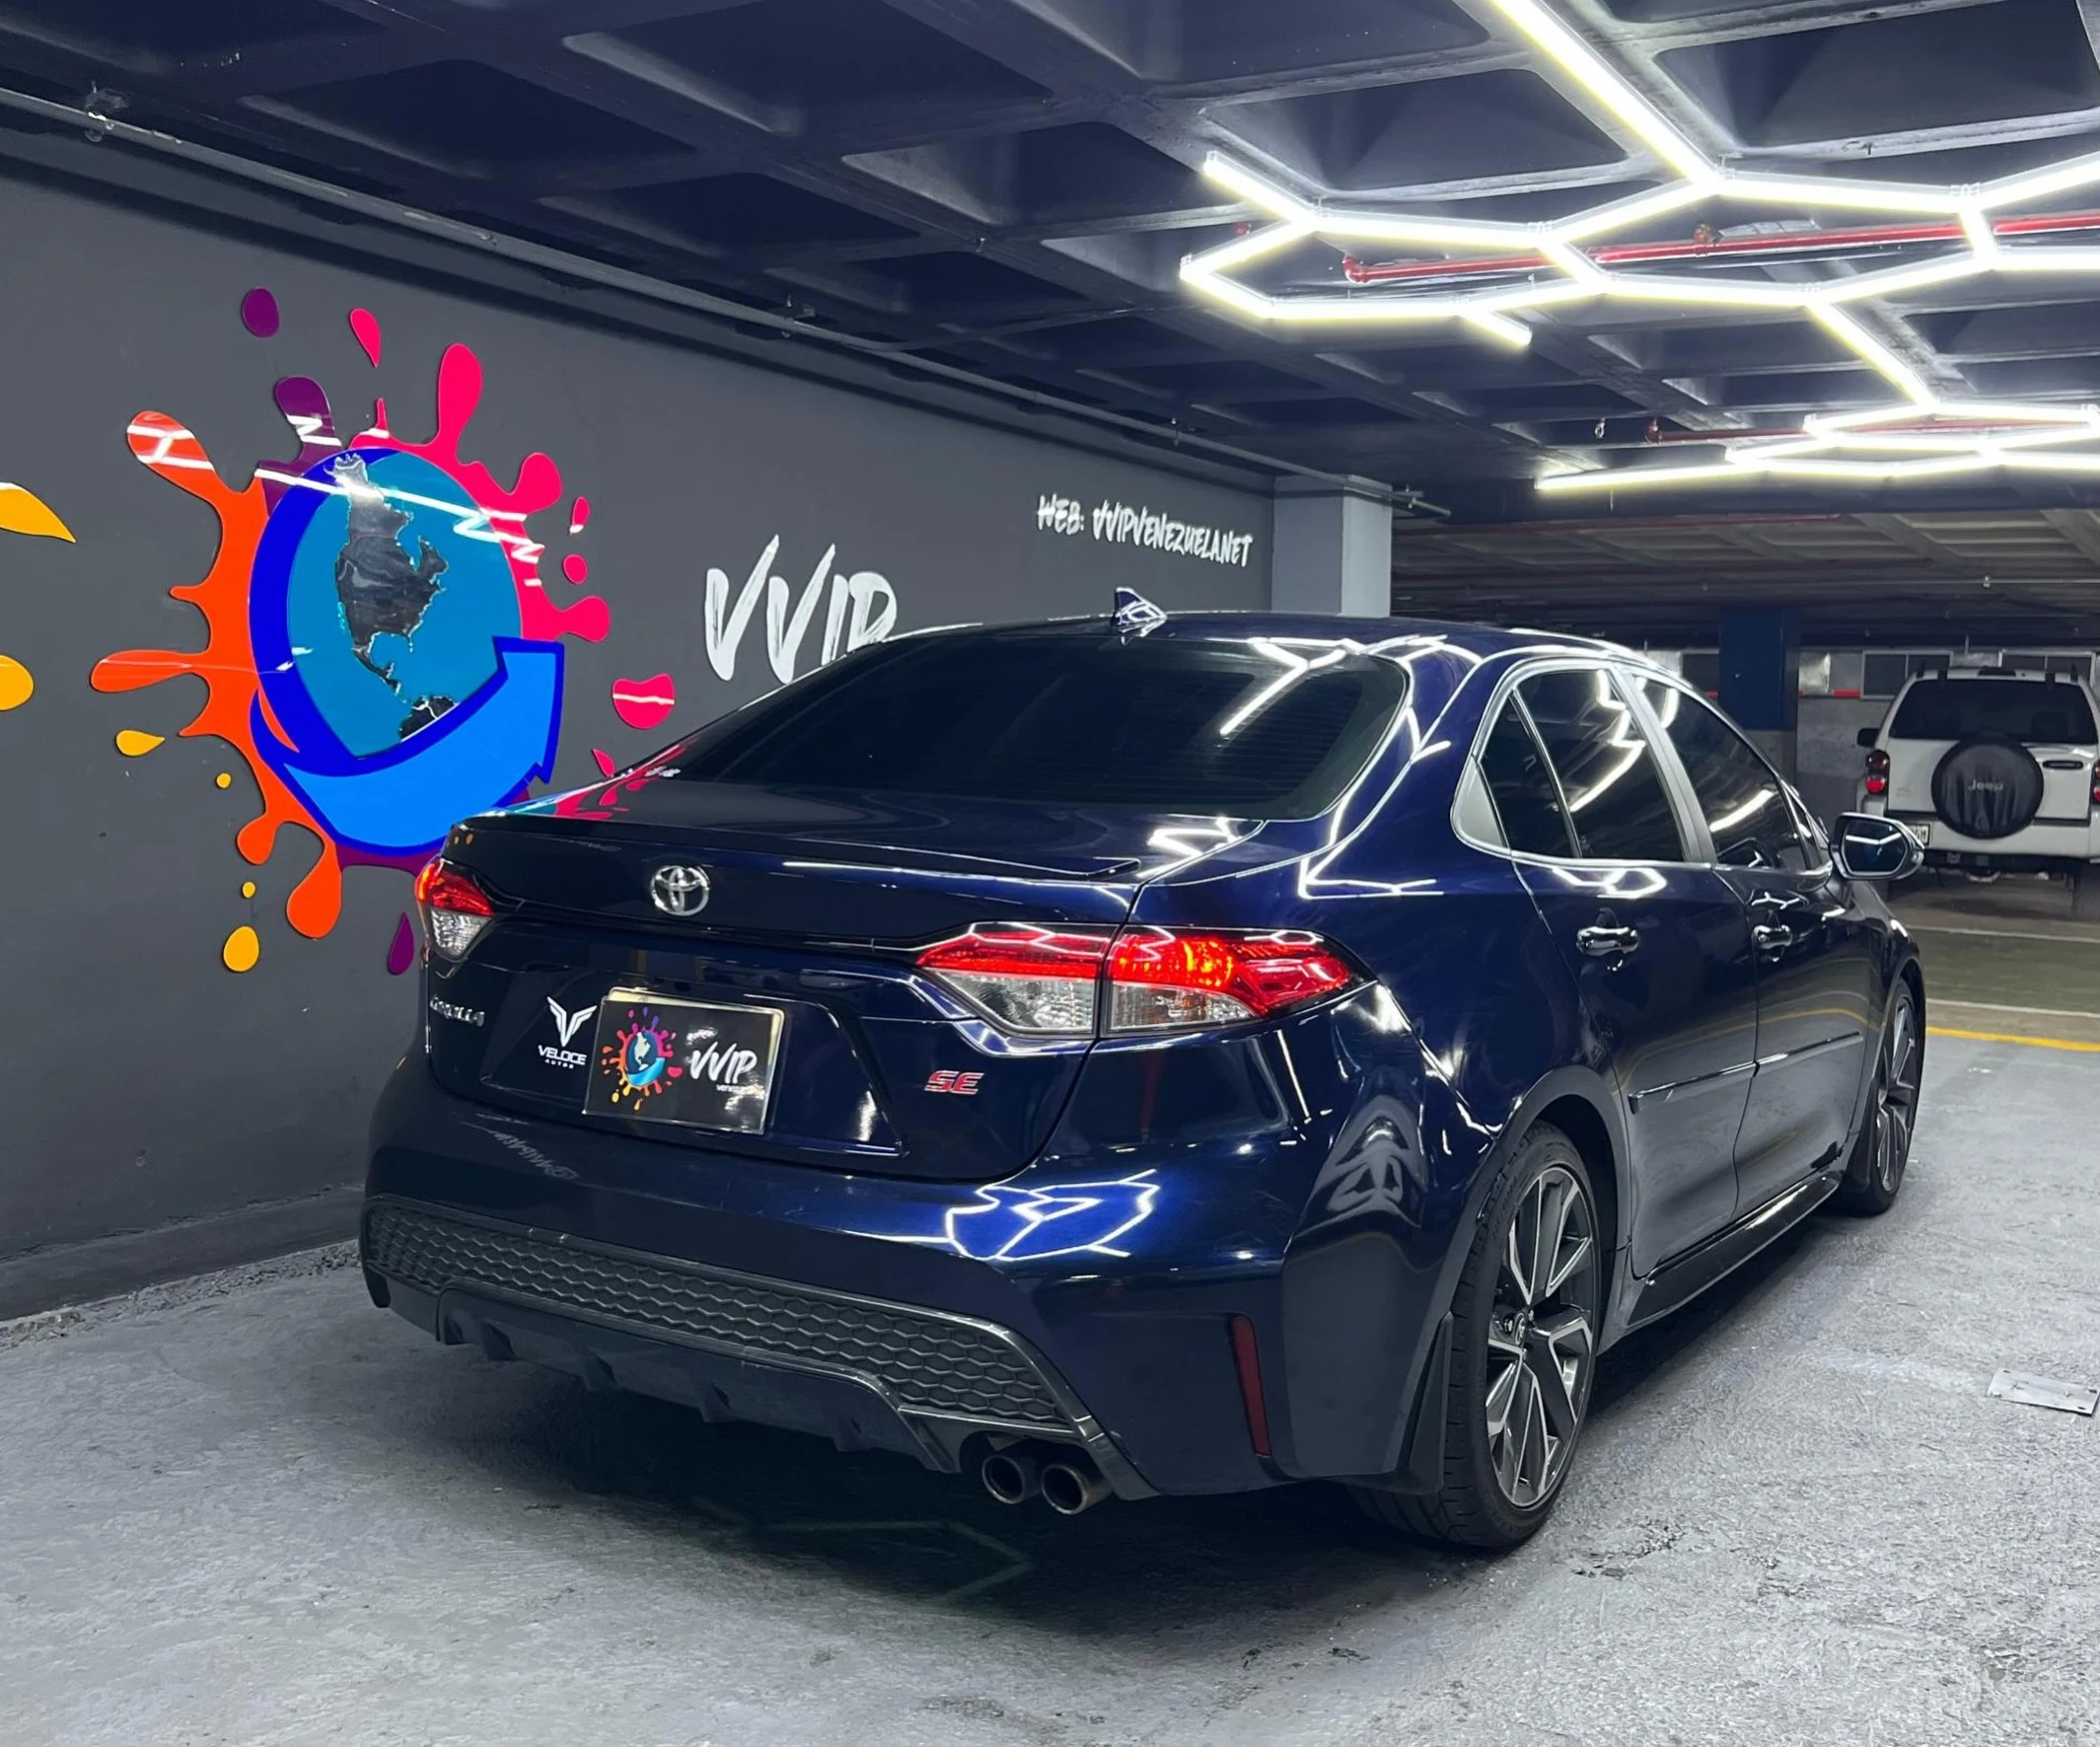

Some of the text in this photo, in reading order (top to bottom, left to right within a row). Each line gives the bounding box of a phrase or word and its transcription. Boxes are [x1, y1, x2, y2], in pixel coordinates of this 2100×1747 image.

[1037, 493, 1085, 535] WEB:
[704, 534, 898, 685] VVIP
[538, 1044, 588, 1065] VELOCE
[689, 1041, 758, 1084] VVIP
[924, 1069, 984, 1095] SE
